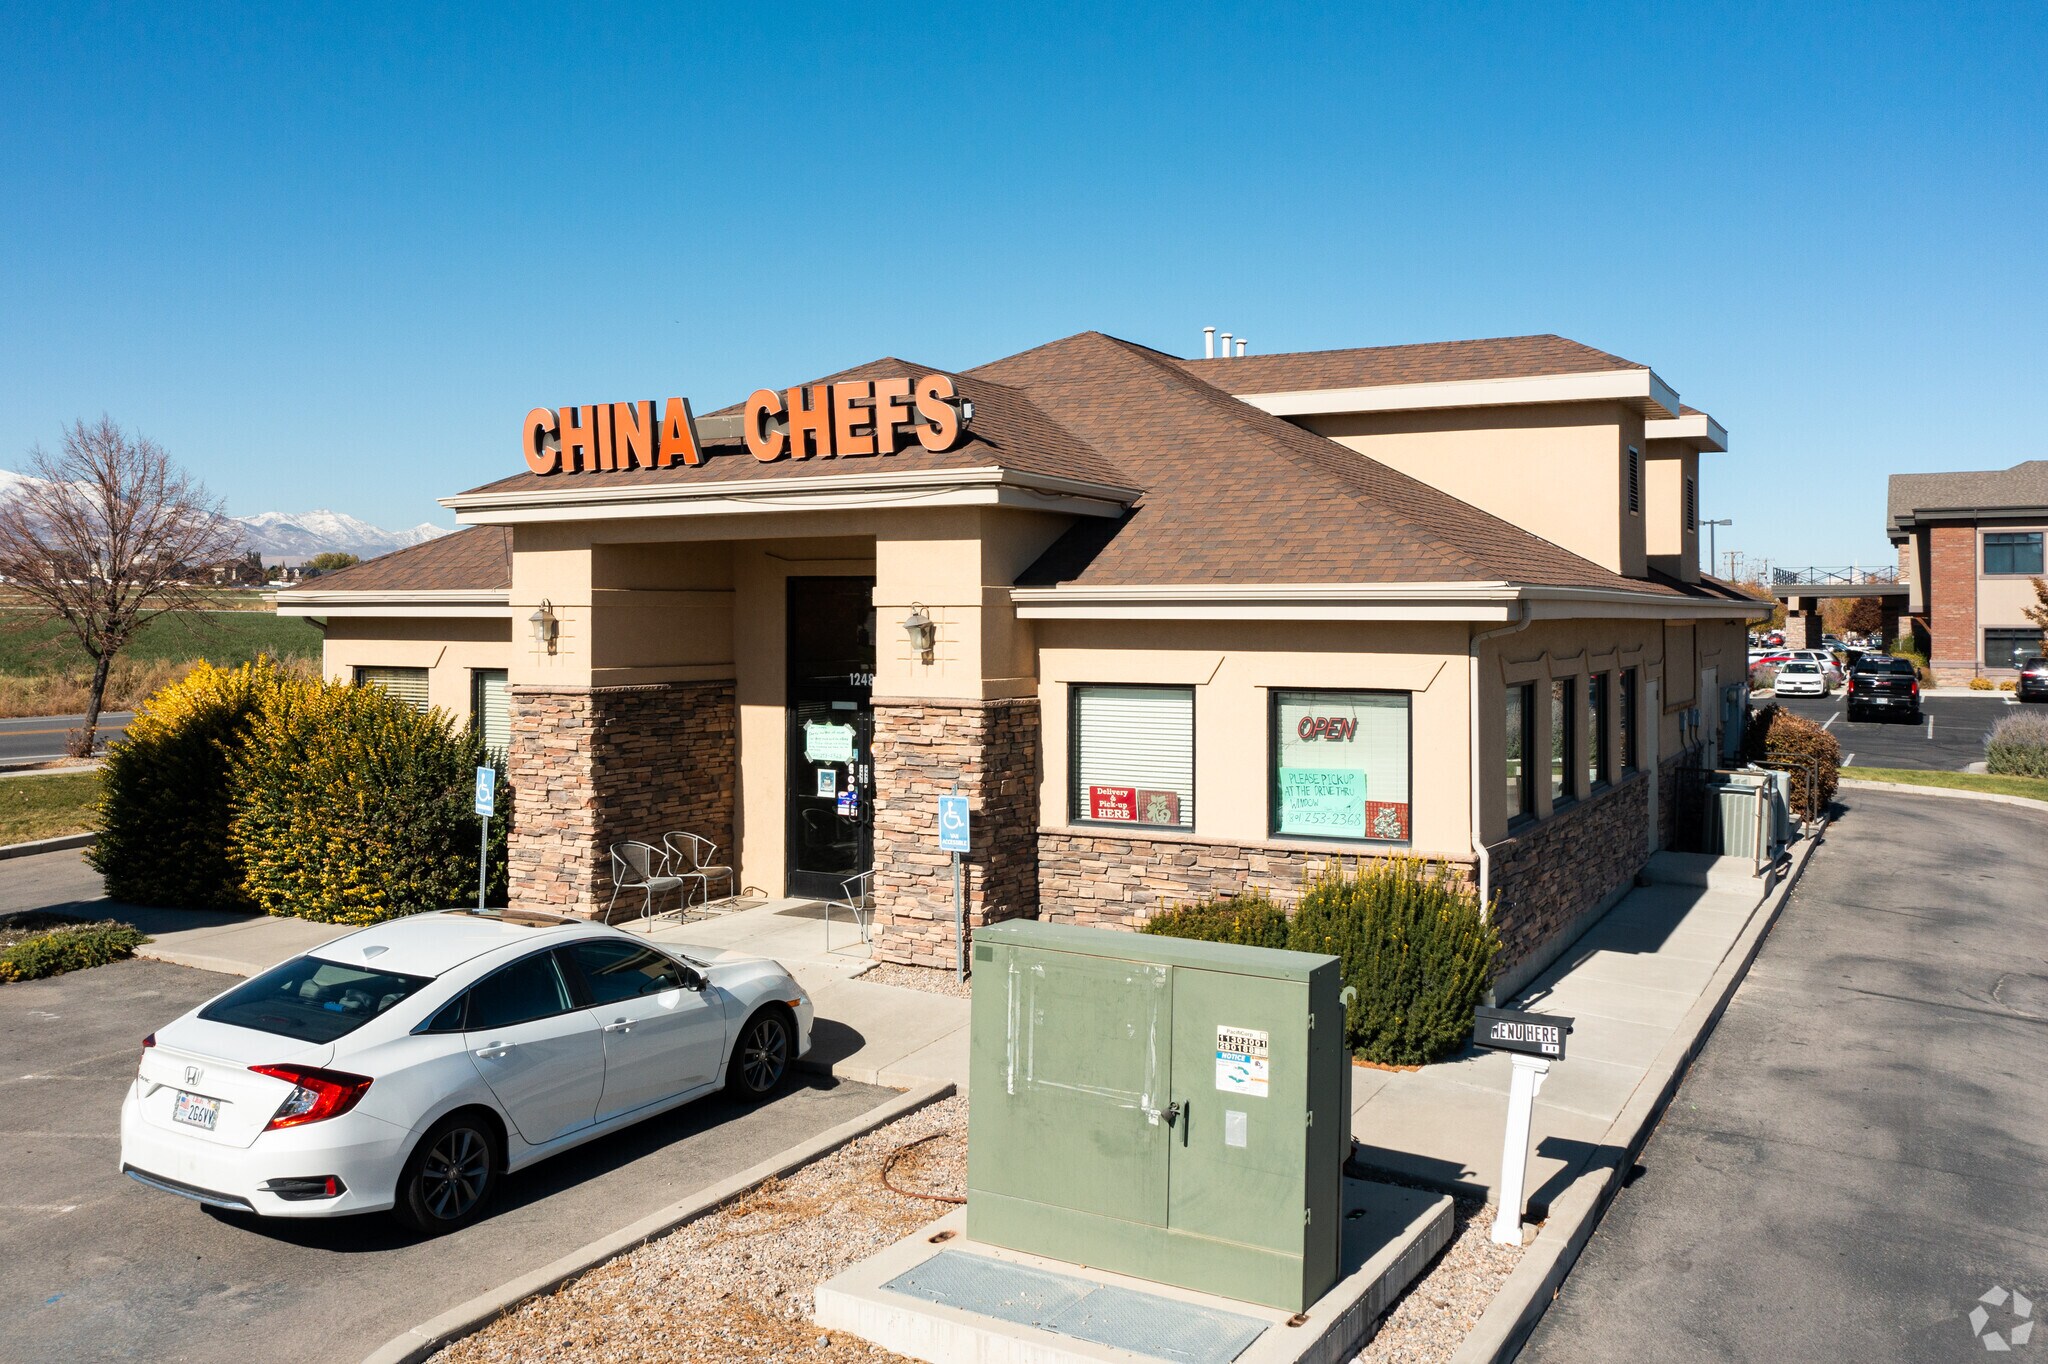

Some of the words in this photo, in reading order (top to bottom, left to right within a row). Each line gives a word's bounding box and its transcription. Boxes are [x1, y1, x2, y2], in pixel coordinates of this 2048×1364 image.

[522, 397, 701, 475] CHINA
[744, 374, 963, 462] CHEFS
[850, 672, 874, 686] 1248
[1297, 716, 1358, 741] OPEN
[1289, 773, 1320, 784] PLEASE
[1097, 788, 1128, 797] Delivery
[1285, 786, 1294, 796] AT
[1296, 786, 1310, 796] THE
[1099, 800, 1127, 810] Pick-up
[1290, 798, 1318, 809] WINDOW
[1098, 808, 1130, 819] HERE
[1492, 1023, 1523, 1039] MENU
[1526, 1025, 1557, 1042] HERE
[1219, 1035, 1267, 1047] 11303001
[1221, 1052, 1246, 1062] NOTICE
